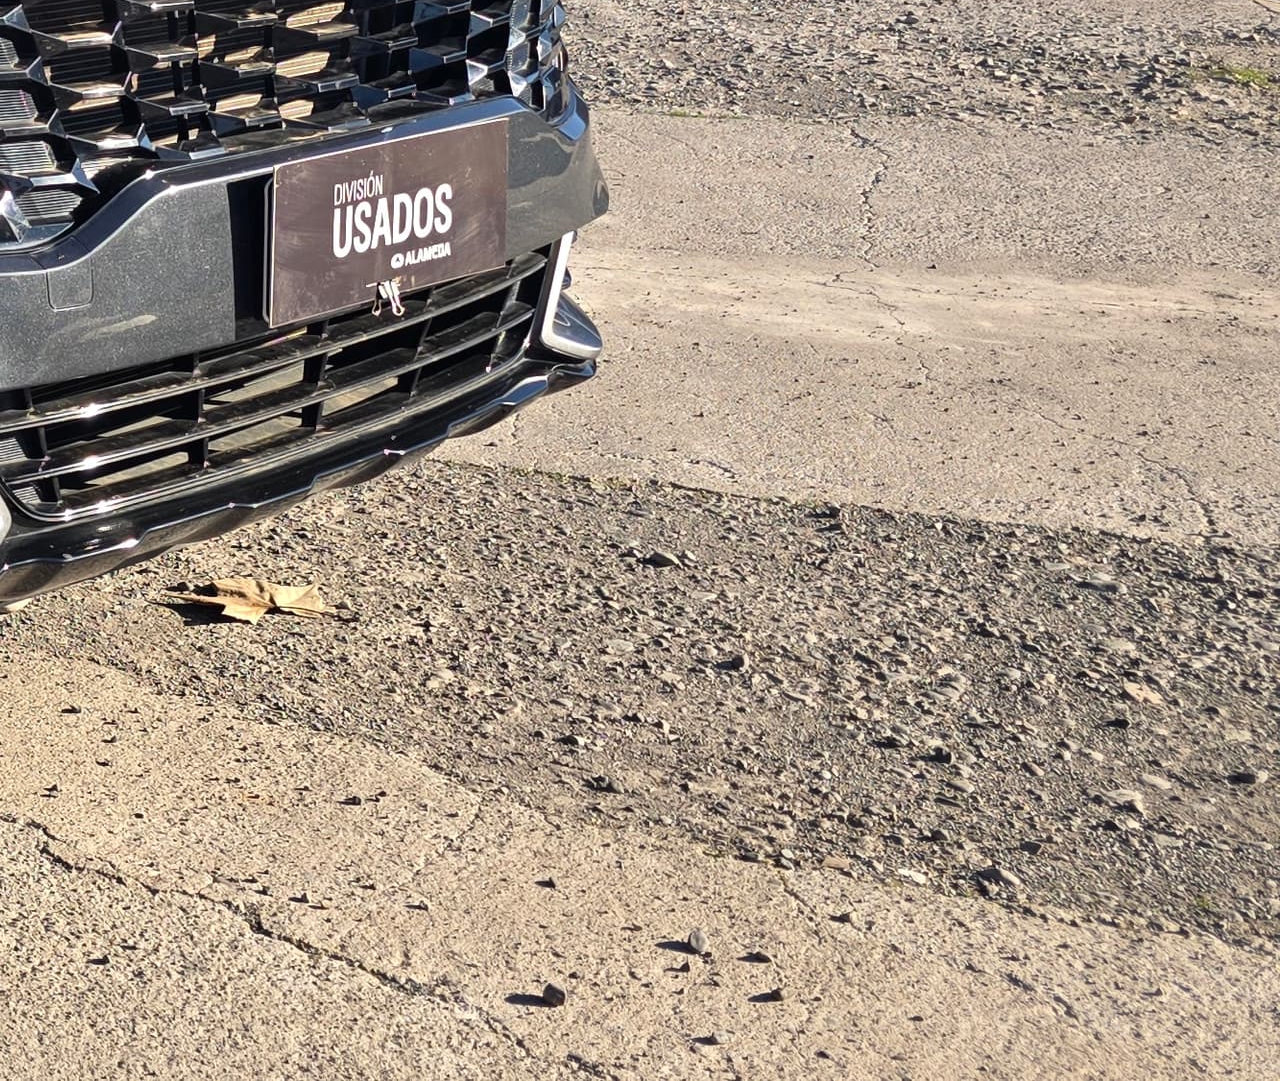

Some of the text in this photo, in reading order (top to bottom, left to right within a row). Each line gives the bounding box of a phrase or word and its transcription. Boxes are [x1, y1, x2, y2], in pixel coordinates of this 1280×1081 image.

[333, 170, 384, 206] DIVISIÓN
[332, 183, 453, 258] USADOS
[404, 242, 451, 267] ALAMEDA
